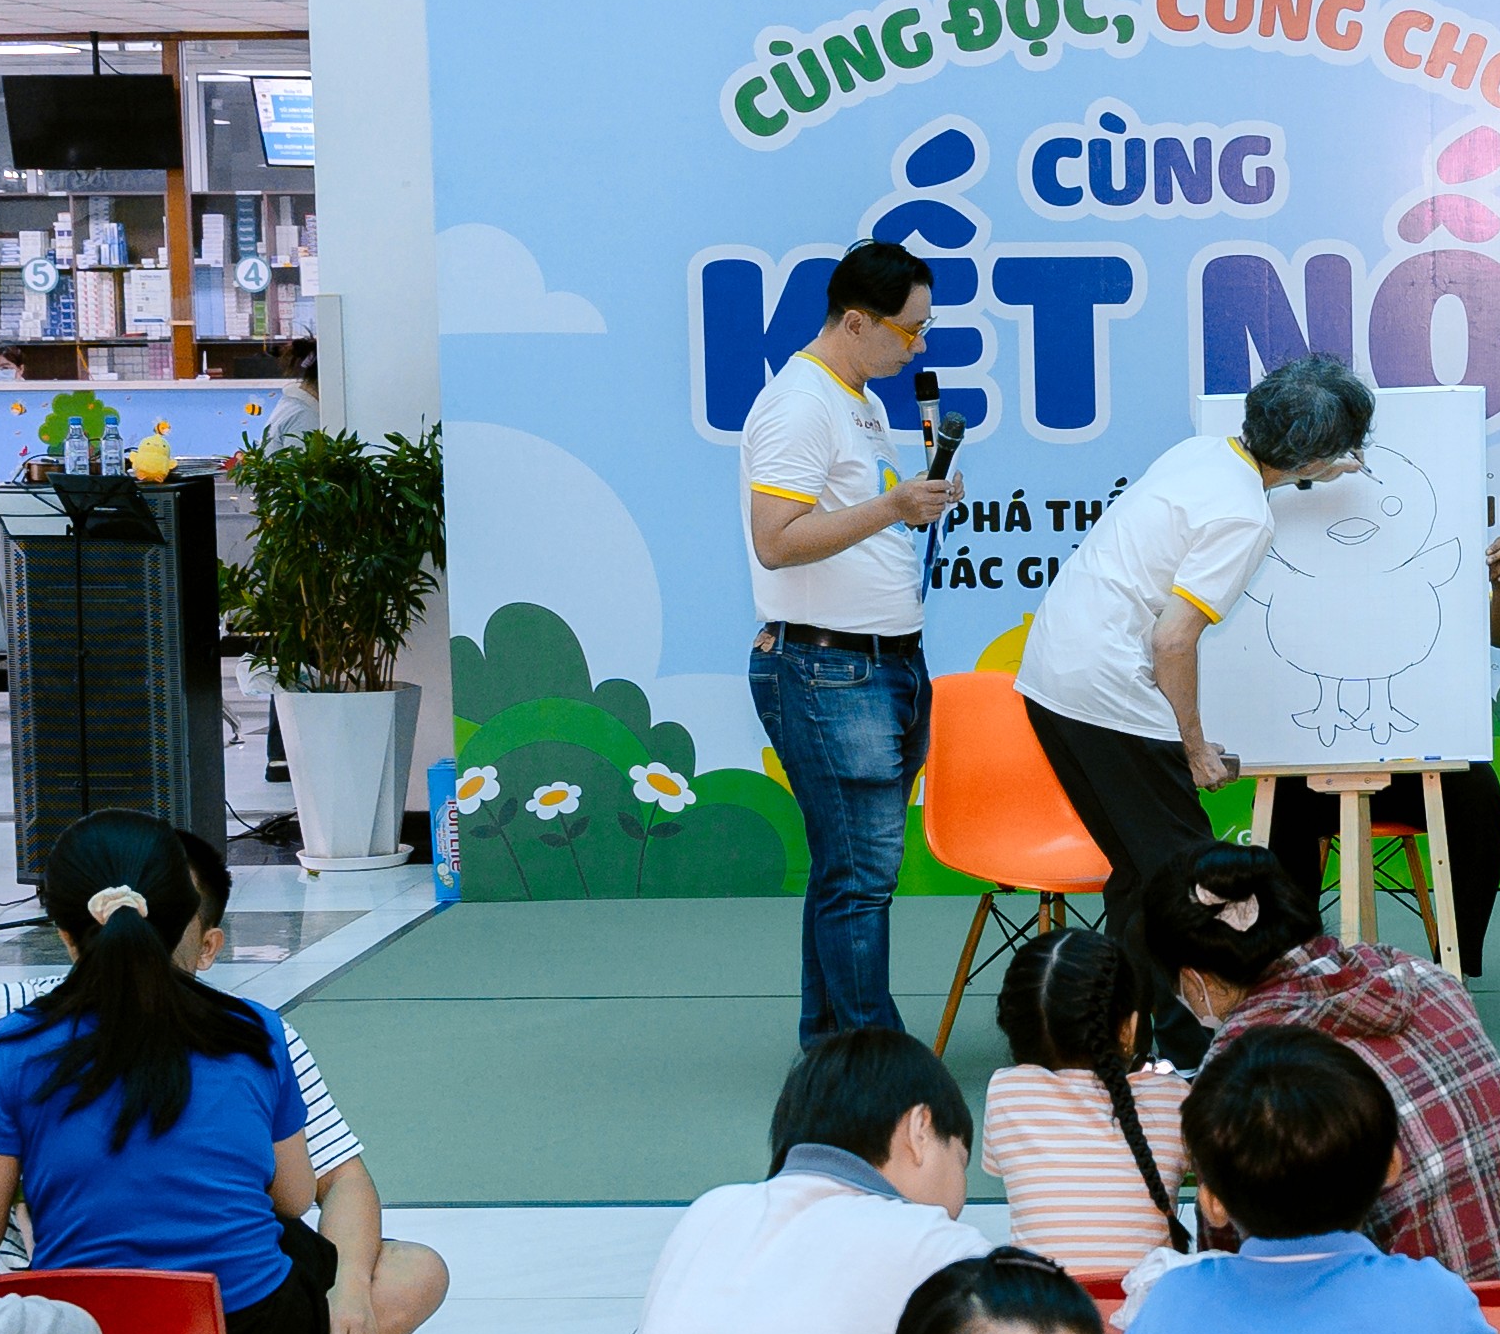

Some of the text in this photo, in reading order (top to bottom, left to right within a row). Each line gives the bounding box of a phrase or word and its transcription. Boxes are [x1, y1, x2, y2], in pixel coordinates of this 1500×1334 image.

[734, 7, 934, 137] CÙNG
[1031, 111, 1275, 206] CÙNG
[31, 263, 50, 288] 5
[244, 262, 263, 286] 4
[947, 476, 1128, 533] PHÁ TH
[931, 545, 1004, 590] TÁC
